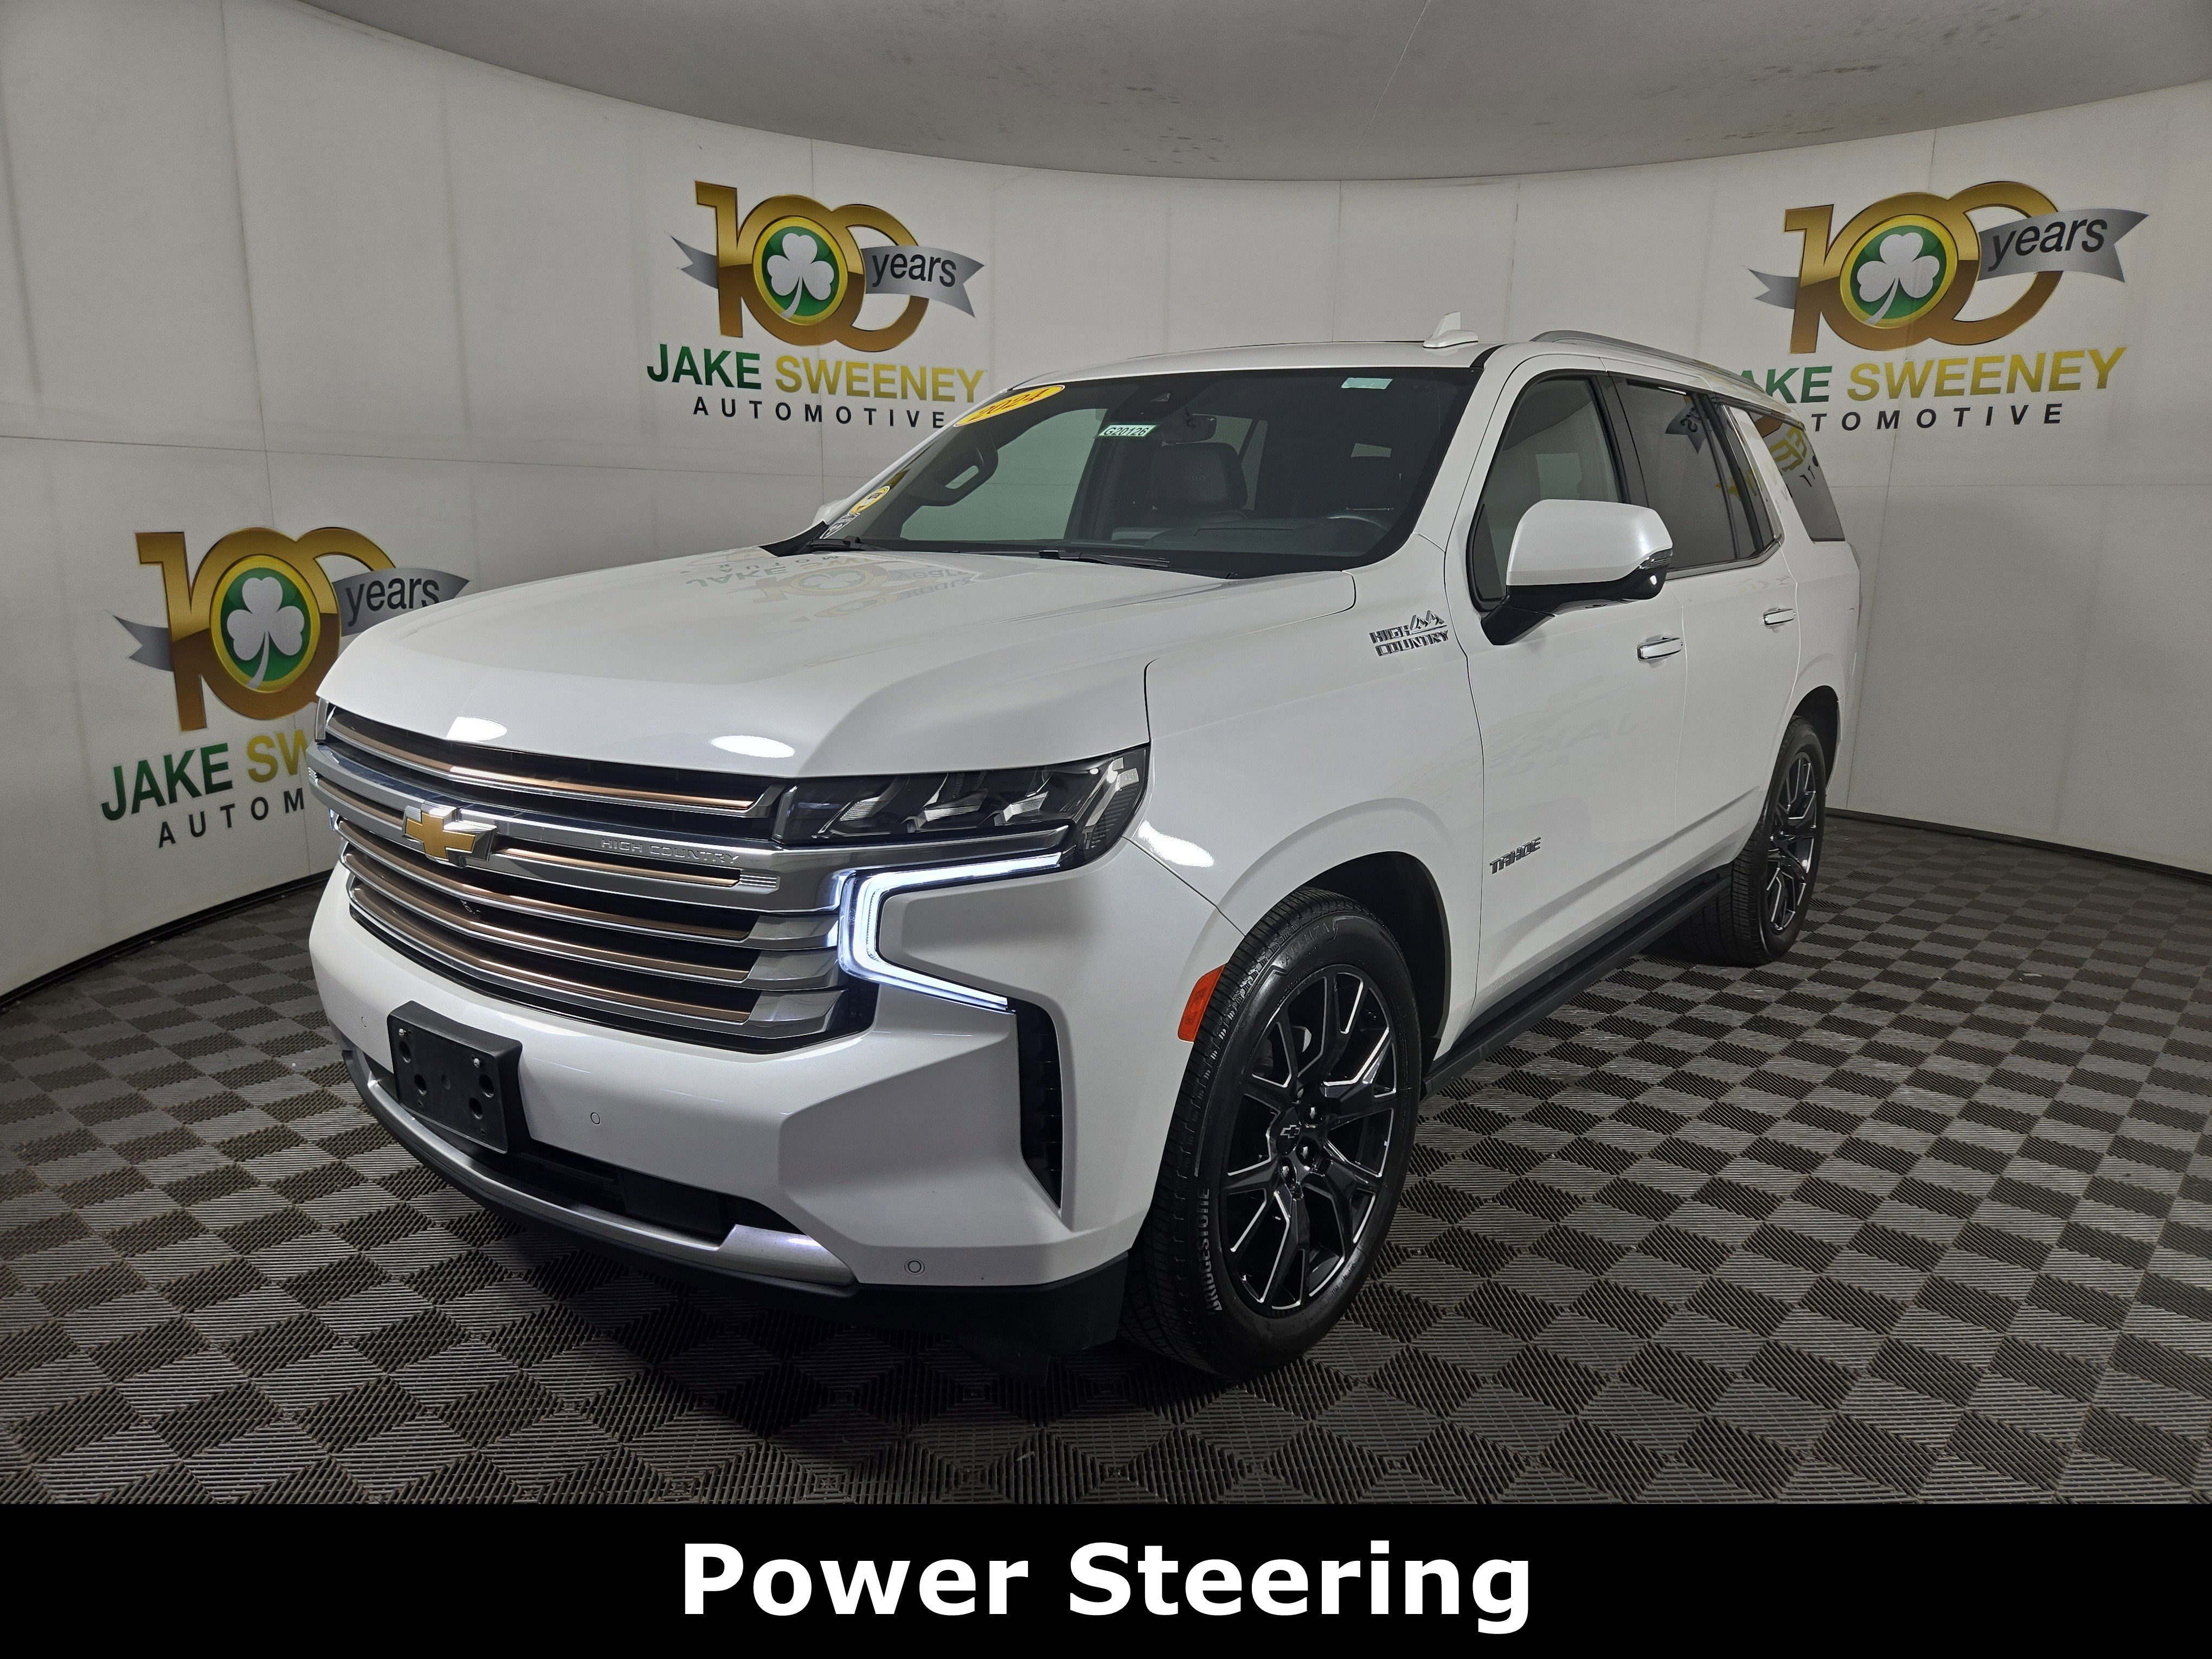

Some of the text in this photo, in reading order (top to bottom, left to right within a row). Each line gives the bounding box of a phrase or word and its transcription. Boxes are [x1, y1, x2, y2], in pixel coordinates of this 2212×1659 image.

[1988, 218, 2108, 272] years
[871, 253, 957, 288] years
[647, 343, 985, 403] JAKE SWEENEY
[1741, 346, 2127, 404] KE SWEENEY
[693, 396, 946, 429] AUTOMOTIVE
[968, 388, 1050, 422] 2024
[1811, 403, 2063, 433] TOMOTIVE
[1103, 427, 1149, 436] G20126
[345, 577, 440, 627] years
[1369, 625, 1410, 644] HIGH
[1375, 629, 1449, 657] COUNTRY
[101, 743, 233, 821] JAKE
[158, 788, 305, 848] AUTOM
[601, 838, 740, 866] HIGH COUNTRY
[1489, 837, 1541, 874] TAHOE
